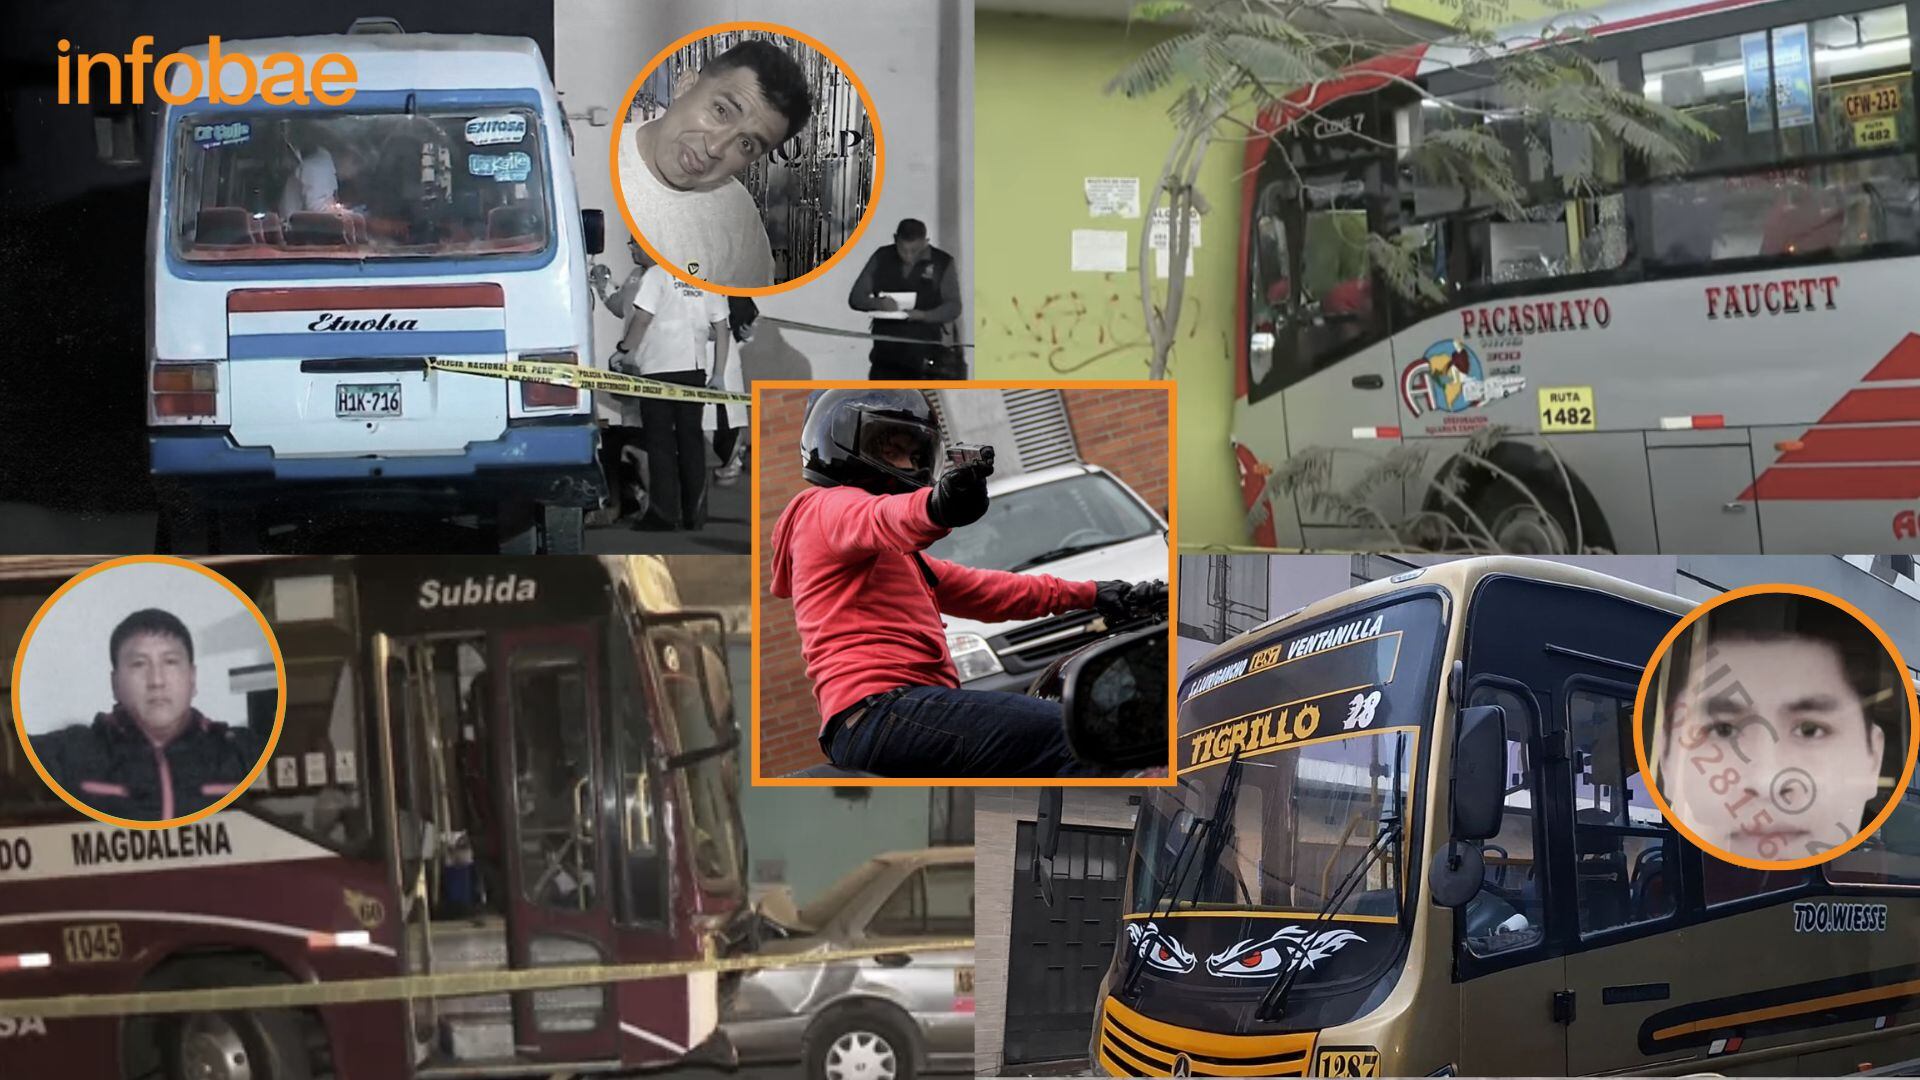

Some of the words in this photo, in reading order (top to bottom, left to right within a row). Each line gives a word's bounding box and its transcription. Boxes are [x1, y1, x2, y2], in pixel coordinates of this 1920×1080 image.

[1846, 89, 1898, 115] CFW-232
[466, 120, 525, 134] EXITOSA
[1705, 276, 1838, 319] FAUCETT
[1461, 297, 1611, 338] PACASMAYO
[338, 392, 399, 412] H1K-716
[1549, 392, 1581, 403] RUTA
[1542, 407, 1592, 425] 1482
[419, 574, 537, 608] Subida
[1286, 614, 1384, 660] VENTANILLA
[1191, 704, 1321, 765] TIGRILLO
[71, 822, 232, 866] MAGDALENA
[1793, 903, 1888, 932] TDO.WIESSE
[66, 927, 121, 959] 1045
[1321, 1054, 1379, 1078] 1287
